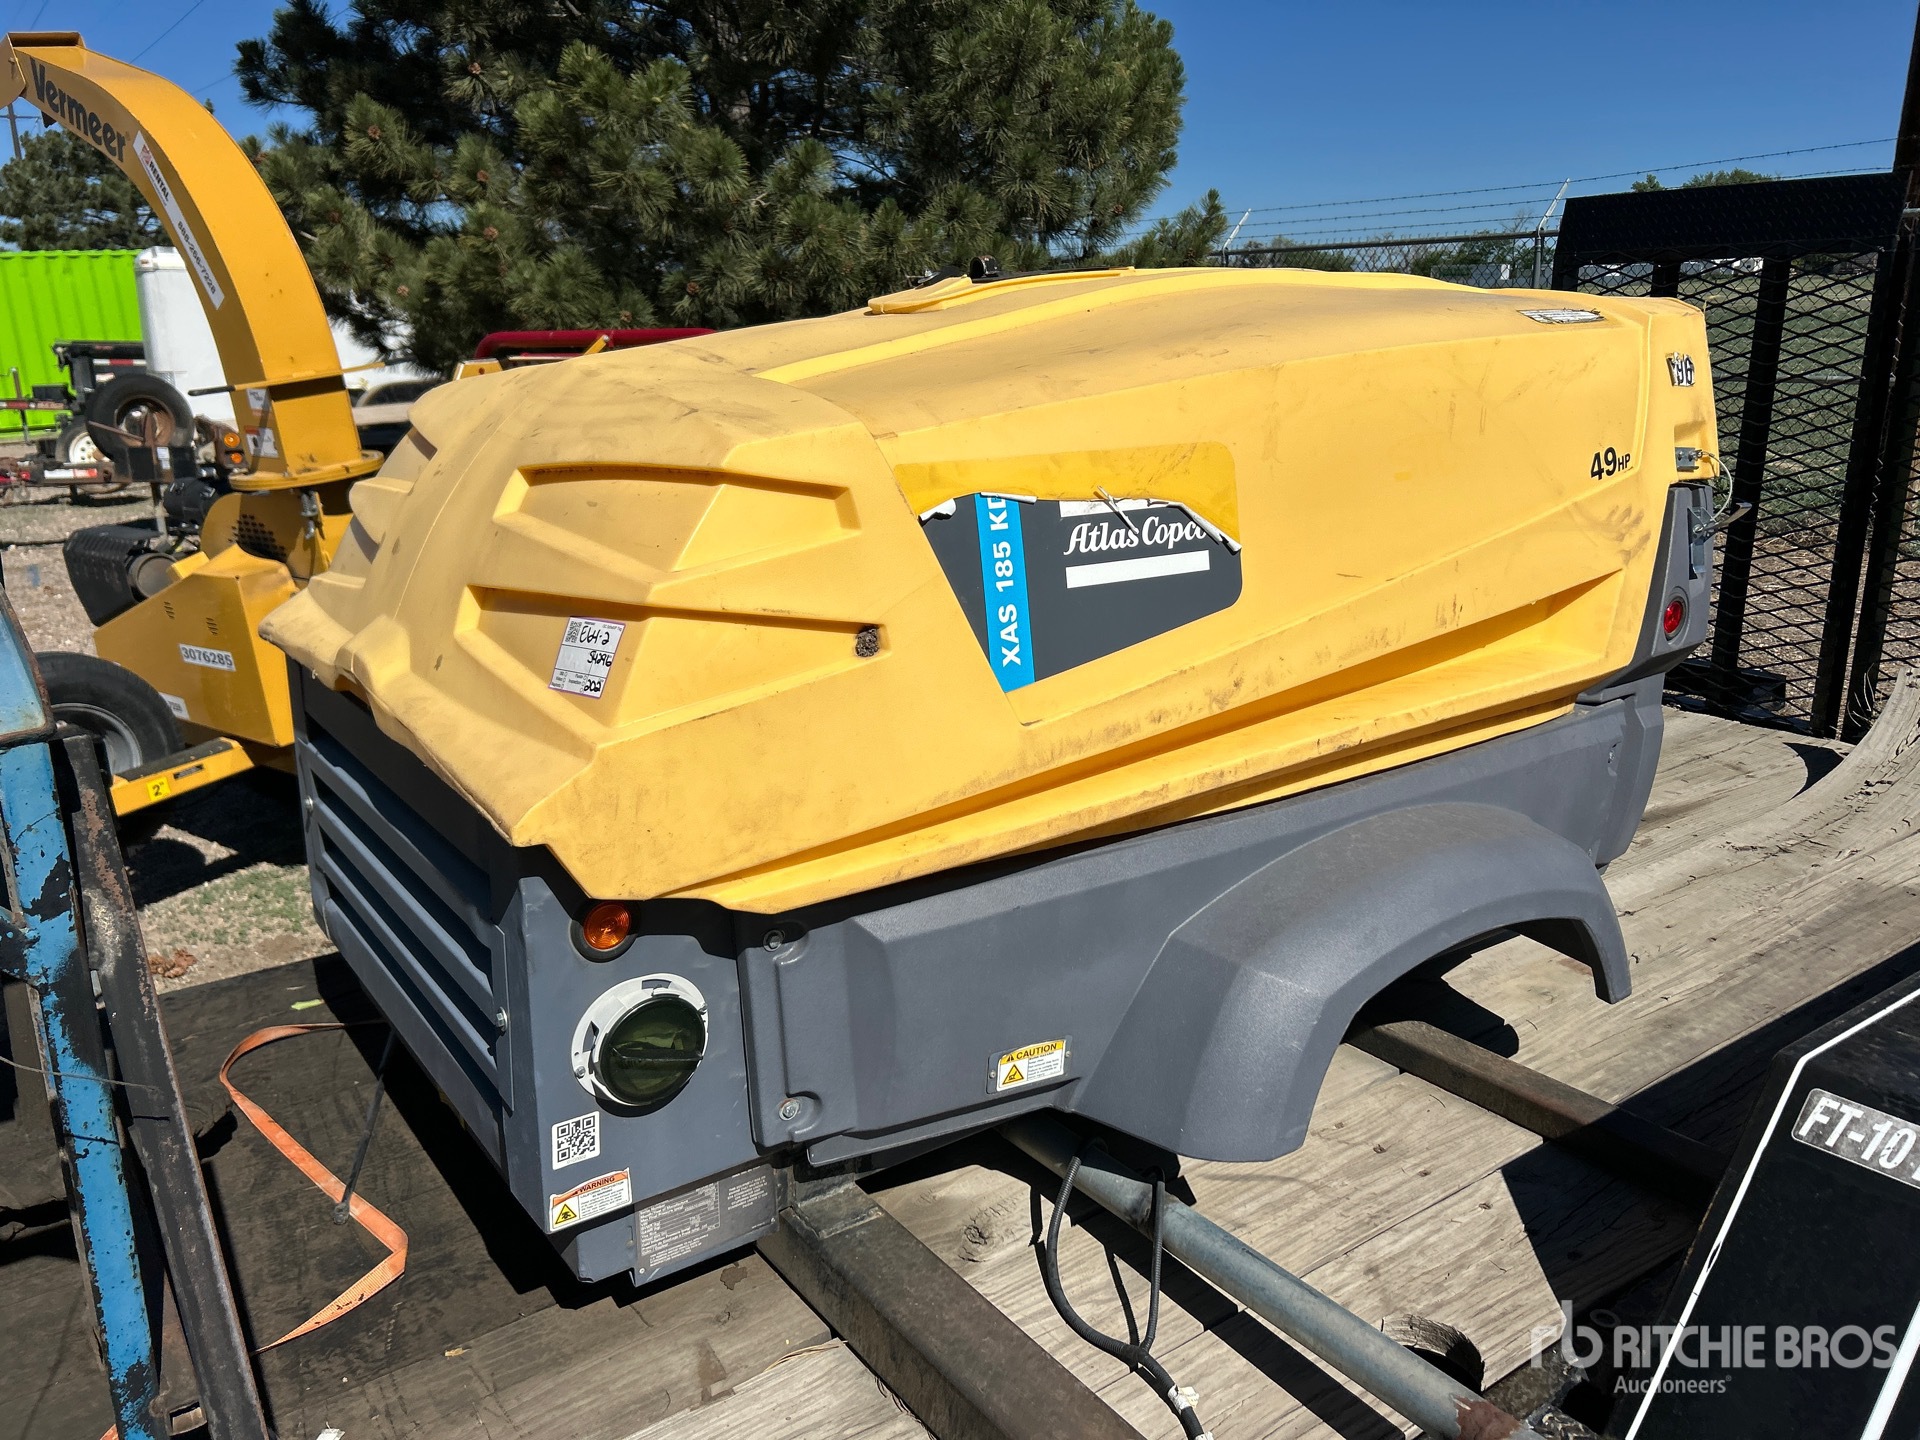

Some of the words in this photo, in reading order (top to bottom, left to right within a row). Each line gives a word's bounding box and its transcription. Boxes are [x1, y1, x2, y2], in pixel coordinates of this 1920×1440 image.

[30, 56, 126, 163] Vermeer
[149, 161, 170, 202] RENTAL
[1063, 522, 1139, 556] Atlas
[993, 541, 1014, 592] 185
[998, 603, 1022, 667] XAS
[181, 646, 233, 667] 3076285
[1016, 1043, 1057, 1060] CAUTION
[580, 1176, 615, 1193] WARNING
